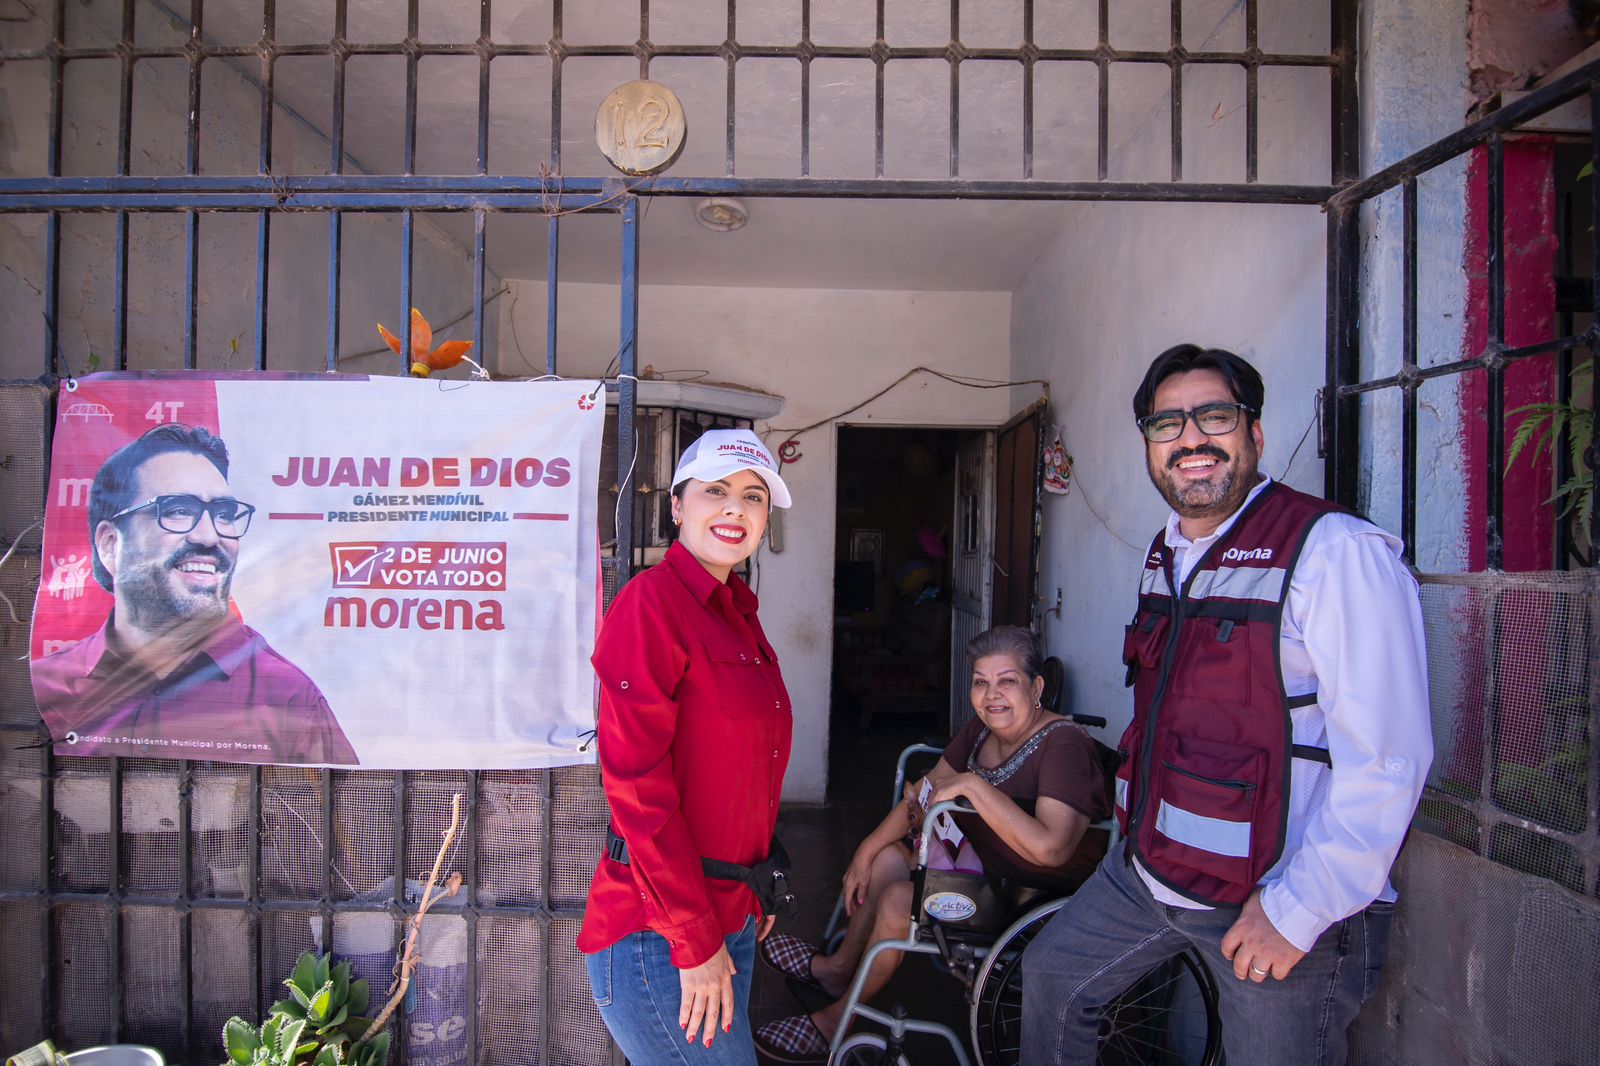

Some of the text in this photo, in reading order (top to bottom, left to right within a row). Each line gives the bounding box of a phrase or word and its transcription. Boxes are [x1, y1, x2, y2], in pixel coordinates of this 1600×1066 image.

[609, 97, 671, 151] 12
[145, 401, 184, 424] 4T
[271, 456, 571, 488] JUAN DE DIOS
[353, 492, 484, 506] GÁMEZ MENDÍVIL
[327, 511, 509, 522] PRESIDENTE MUNICIPAL
[382, 547, 504, 565] 2 DE JUNIO
[380, 569, 503, 587] VOTA TODO
[323, 596, 506, 631] morena
[122, 736, 169, 746] Presidente
[171, 739, 214, 748] Municipal
[216, 740, 232, 749] por
